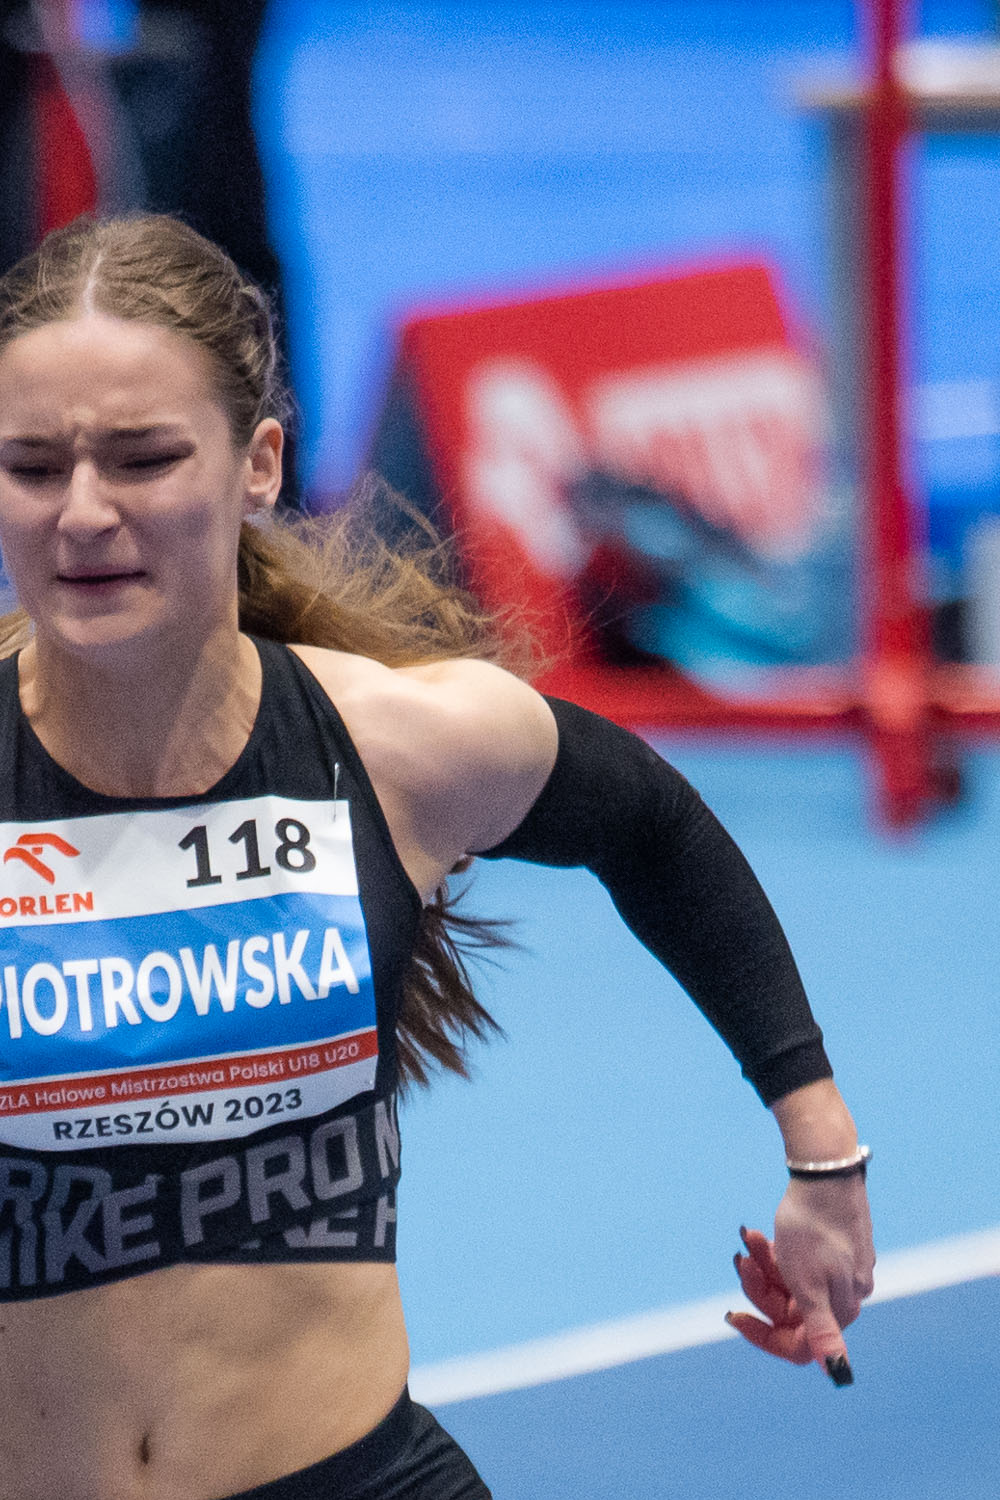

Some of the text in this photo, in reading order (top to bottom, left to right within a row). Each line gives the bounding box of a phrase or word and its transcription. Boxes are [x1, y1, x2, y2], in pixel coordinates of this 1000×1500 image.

[178, 817, 317, 889] 118
[35, 1085, 105, 1106] Halowe
[111, 1069, 225, 1096] Mistrzostwa
[229, 1059, 285, 1081] Polski
[289, 1052, 321, 1073] U18
[325, 1042, 360, 1064] U20
[52, 1088, 303, 1140] RZESZÓW 2023
[179, 1115, 364, 1248] PRO
